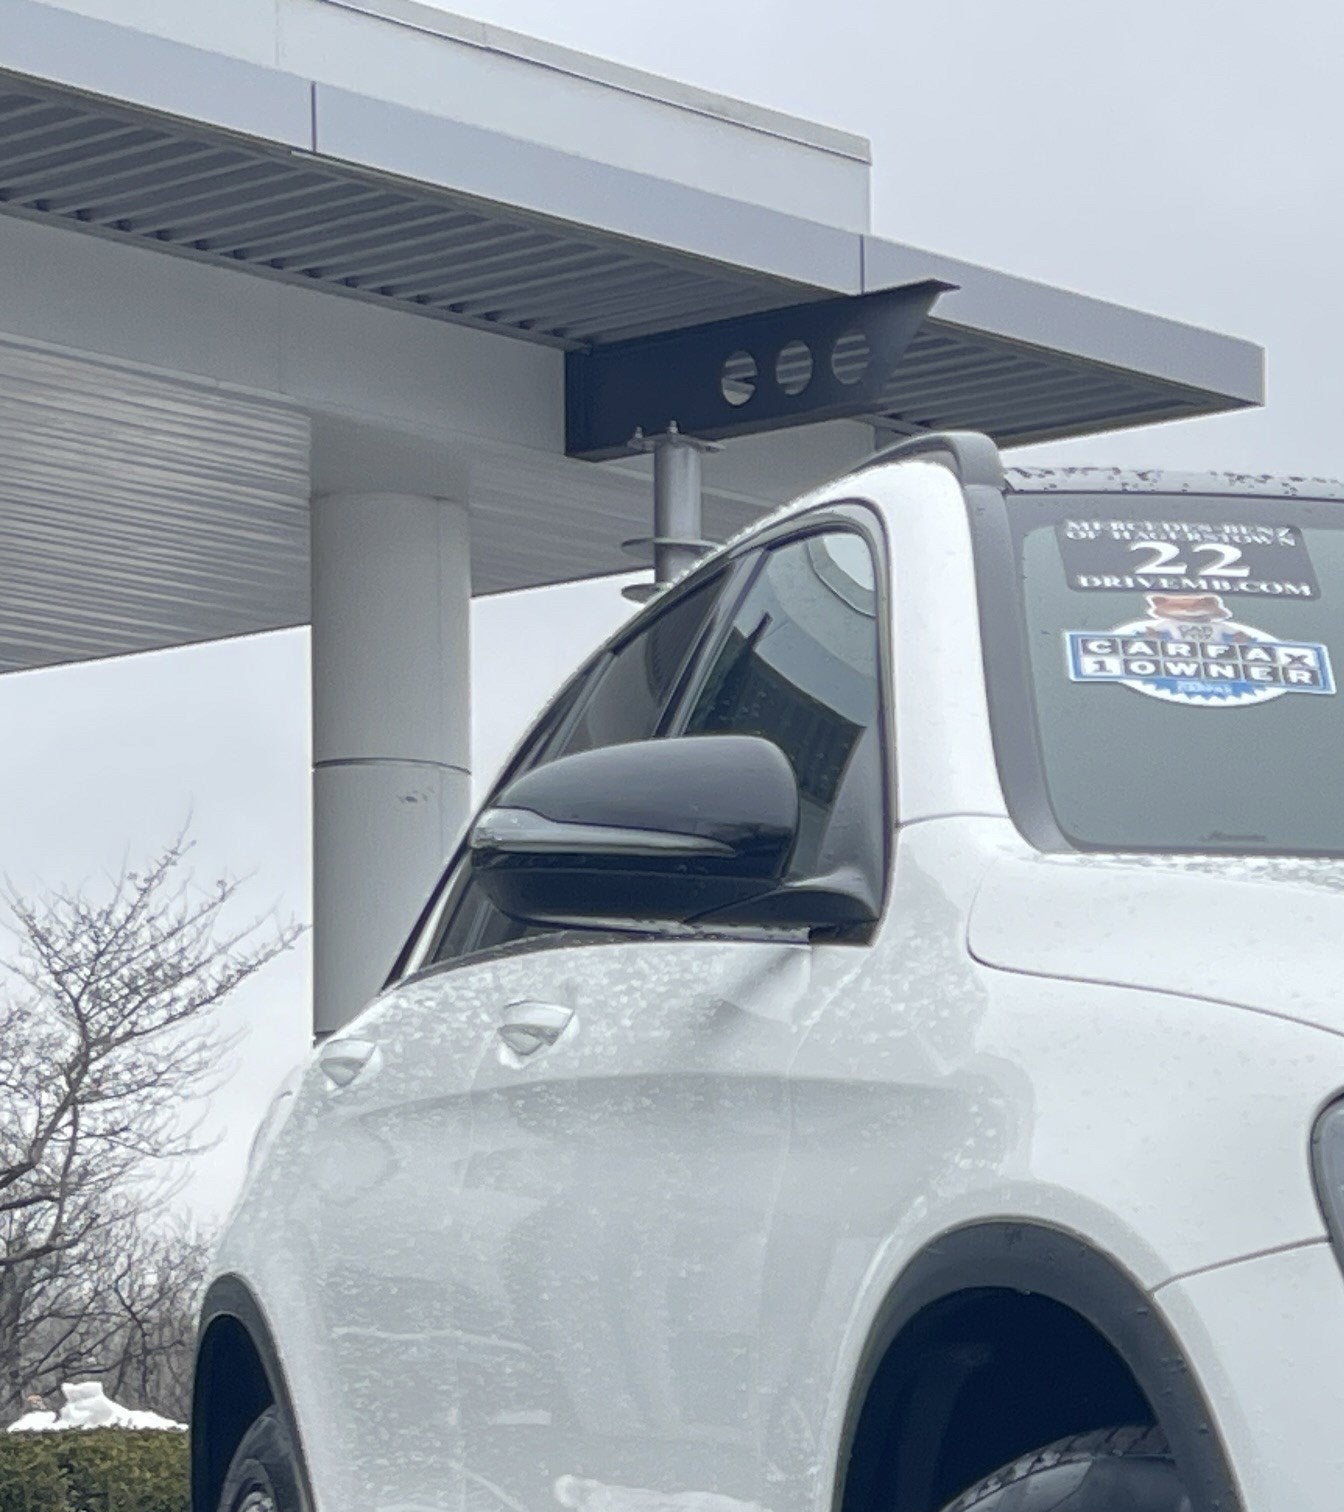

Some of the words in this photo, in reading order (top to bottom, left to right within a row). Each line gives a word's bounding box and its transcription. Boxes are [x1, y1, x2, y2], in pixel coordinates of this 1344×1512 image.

[1129, 540, 1250, 578] 22
[1077, 574, 1312, 597] DRIVEMB.COM
[1086, 639, 1310, 666] CARFAX
[1093, 659, 1114, 673] 1
[1129, 661, 1313, 685] OWNER
